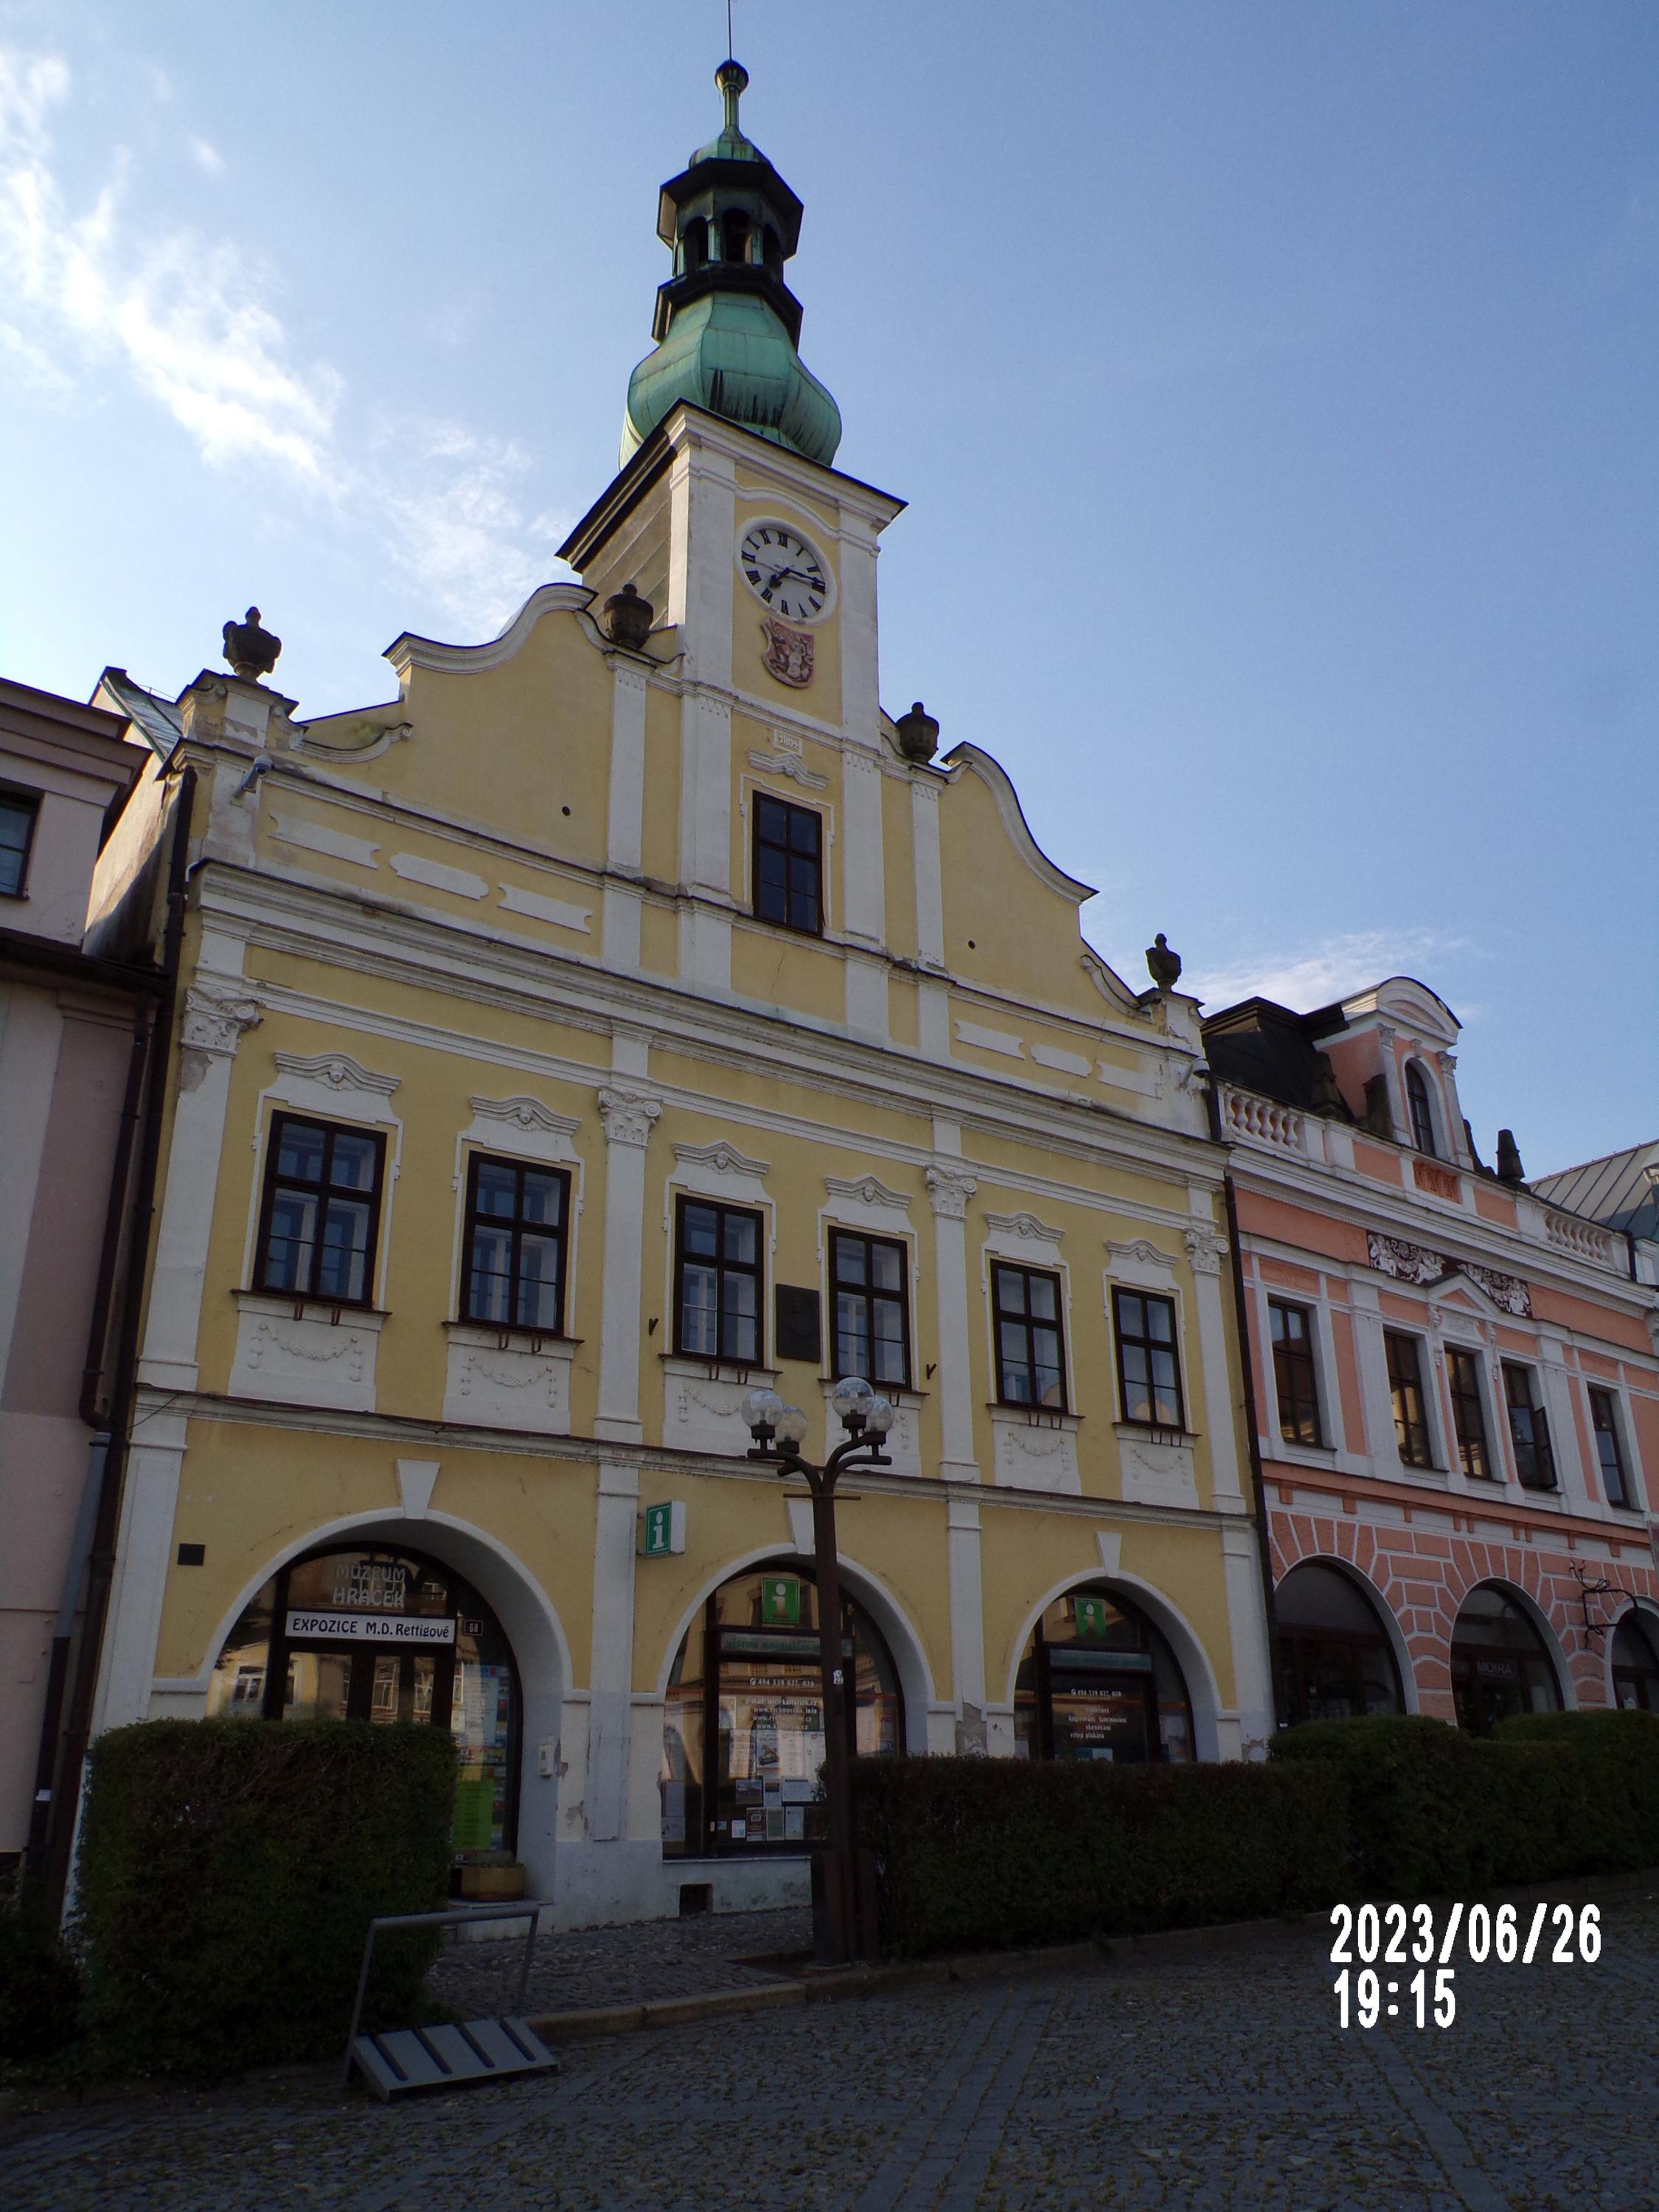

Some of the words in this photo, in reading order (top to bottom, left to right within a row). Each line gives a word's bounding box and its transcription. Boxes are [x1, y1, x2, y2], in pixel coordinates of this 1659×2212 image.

[336, 1563, 406, 1580] MUZEUM
[332, 1586, 406, 1608] HRAČEK
[292, 1618, 358, 1633] EXPOZICE
[366, 1622, 393, 1635] M.D.
[395, 1624, 449, 1638] Rettigové
[469, 1622, 479, 1632] 68
